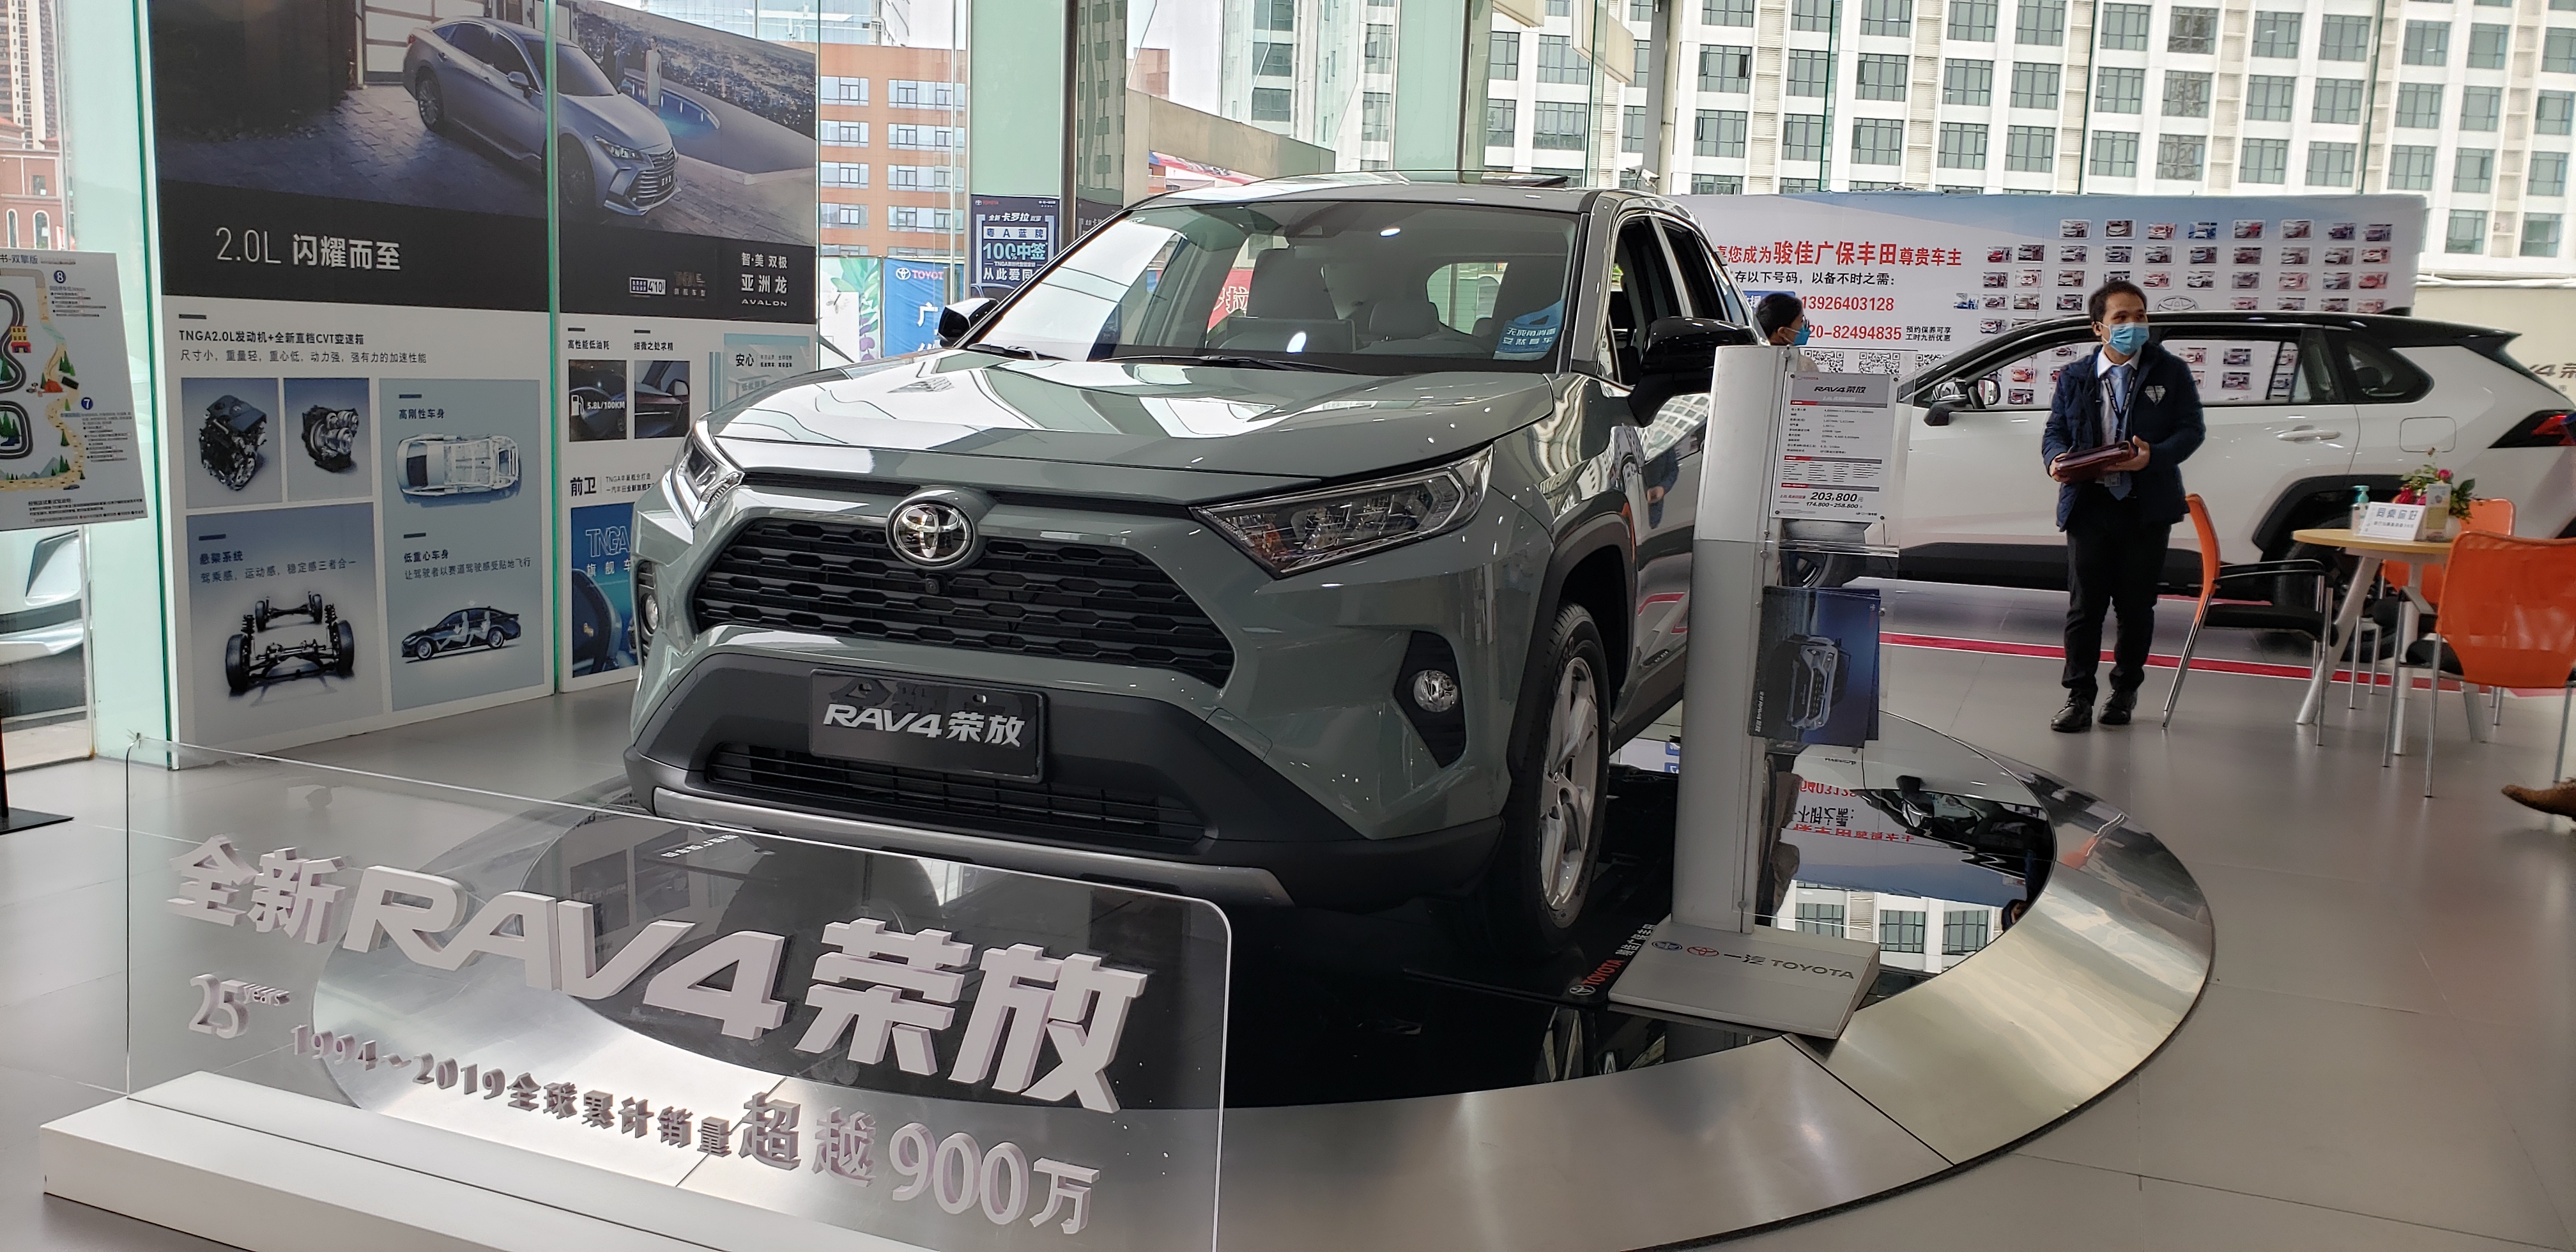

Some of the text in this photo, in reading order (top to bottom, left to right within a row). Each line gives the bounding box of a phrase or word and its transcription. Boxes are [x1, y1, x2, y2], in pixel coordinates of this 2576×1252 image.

[215, 227, 401, 271] 2.0L 闪耀而至
[769, 255, 788, 269] 双极
[912, 270, 944, 280] TOYOT
[983, 268, 1038, 282] 从此爱同
[1731, 270, 1895, 286] 存以下号码，以备不时之需：
[742, 274, 788, 294] 亚洲龙
[1802, 296, 1894, 311] 13926403128
[1810, 324, 1902, 340] 20-82494835
[568, 340, 610, 350] 高性能低油耗
[634, 342, 673, 351] 细微之处求精
[736, 353, 755, 367] 安心
[586, 401, 625, 409] 5.8L/100KM
[399, 409, 445, 420] 高刚性车身
[570, 477, 597, 496] 前卫
[585, 526, 631, 557] TNGA
[199, 551, 243, 565] 悬架系统
[404, 549, 448, 563] 低重心车身
[823, 703, 1025, 747] RAV4荣放
[1581, 959, 1625, 985] TOYOTA
[1723, 954, 1855, 979] 一汽 TOYOTA
[189, 973, 249, 1039] 25
